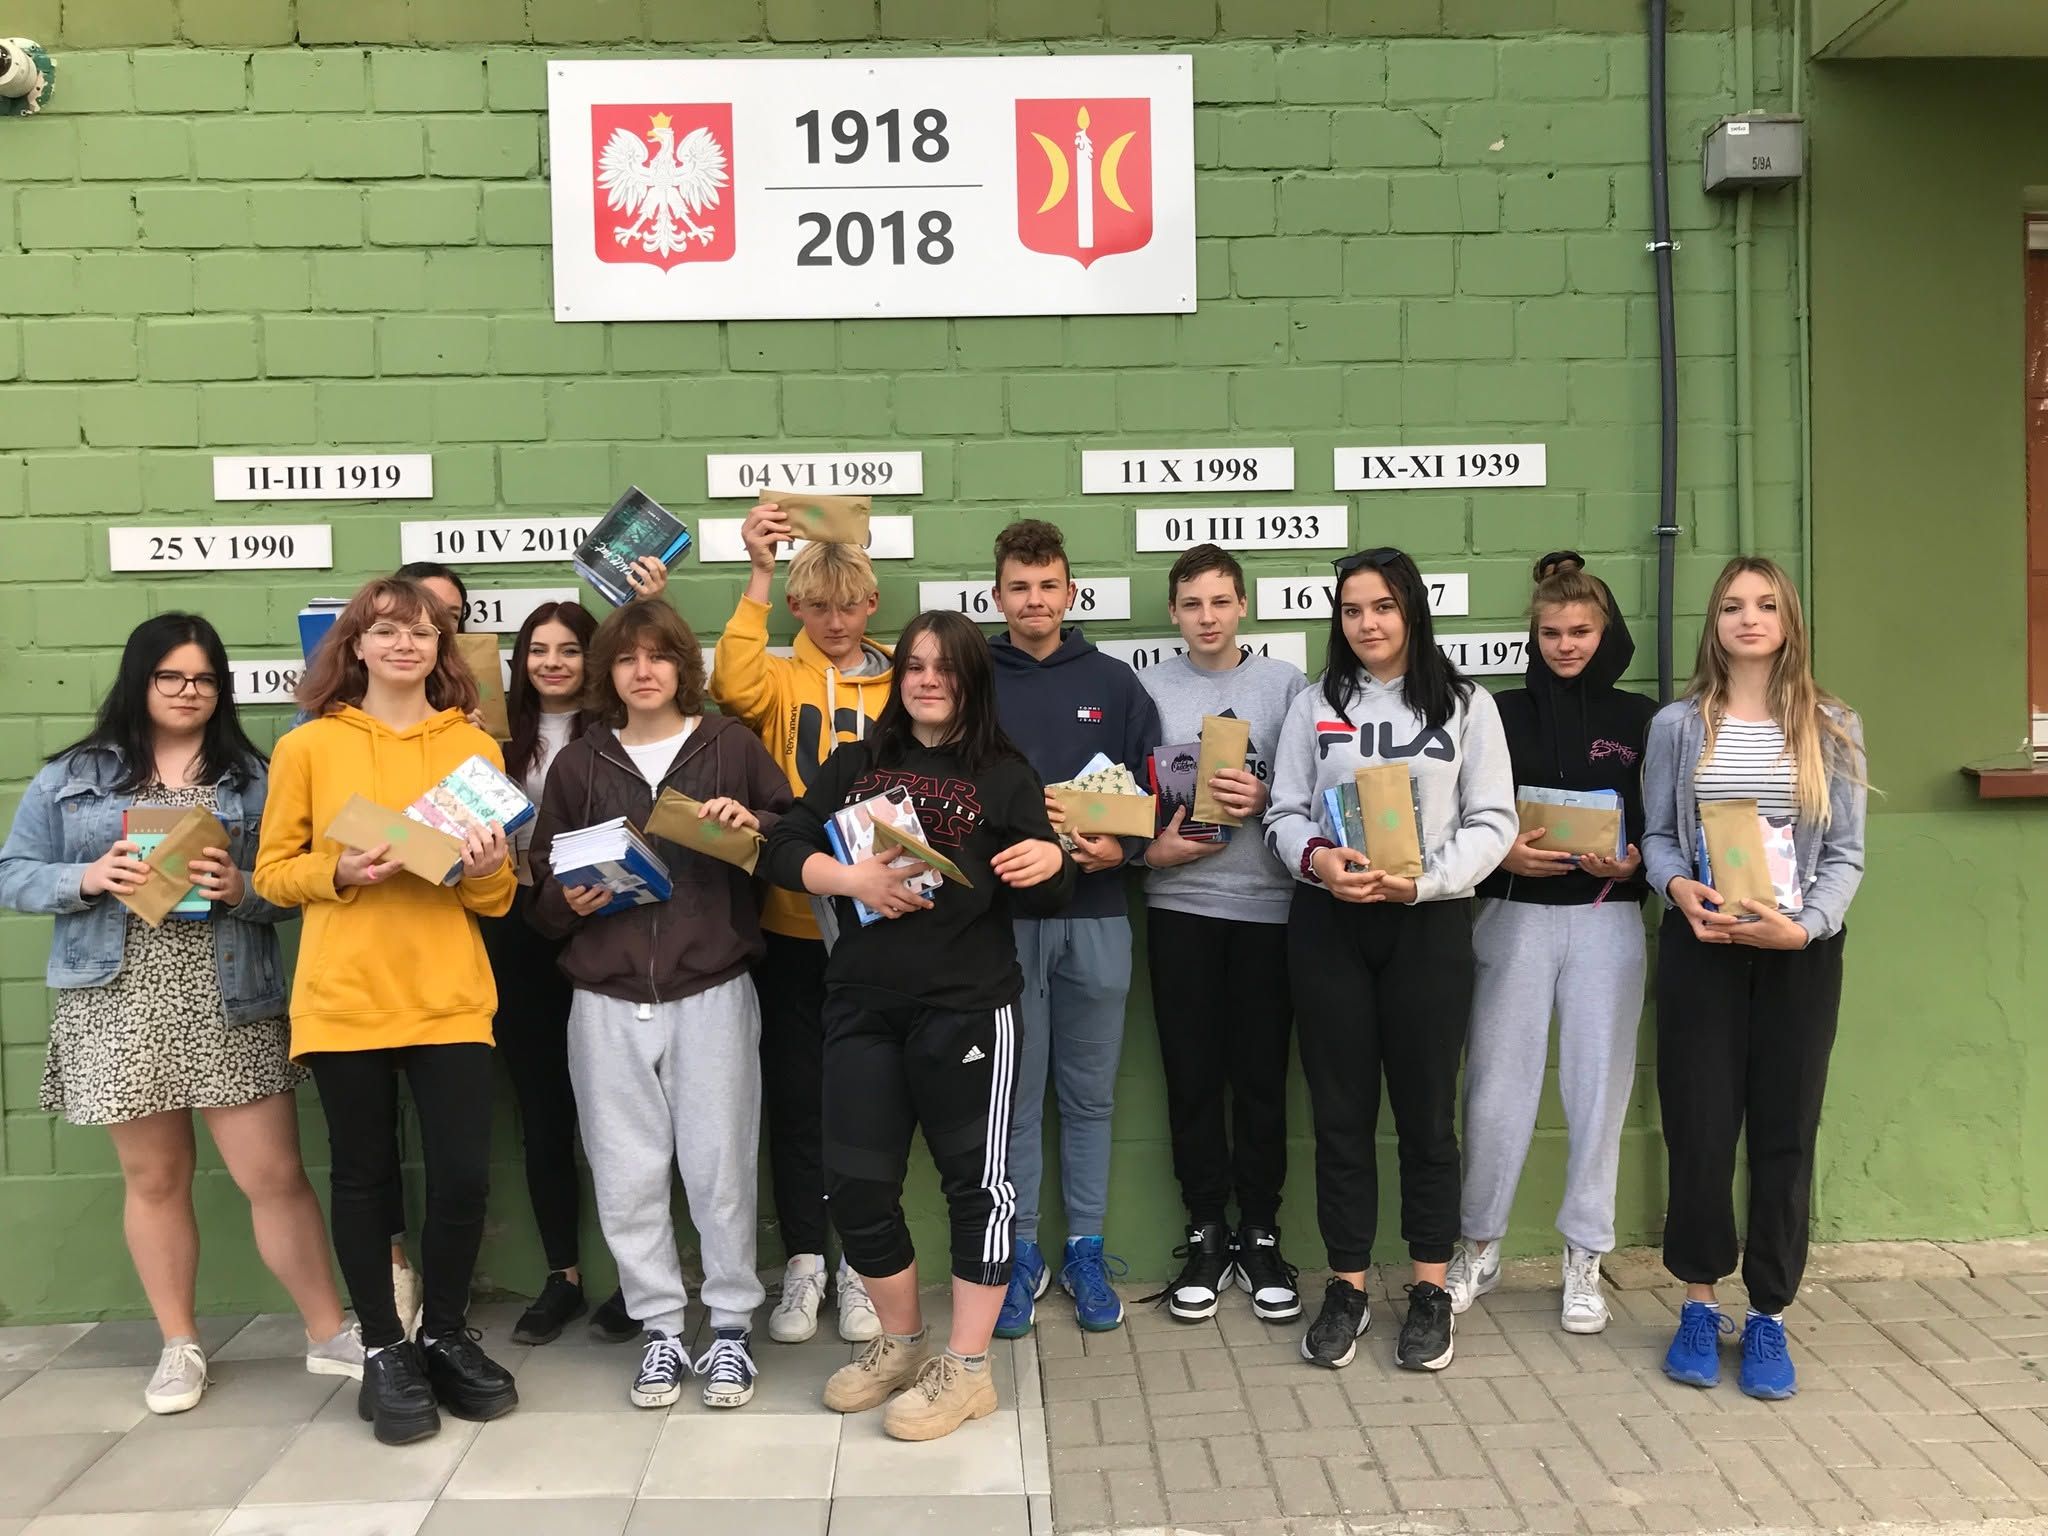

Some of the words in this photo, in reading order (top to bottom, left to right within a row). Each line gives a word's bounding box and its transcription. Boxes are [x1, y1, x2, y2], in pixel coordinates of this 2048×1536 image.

[795, 109, 950, 164] 1918
[1752, 156, 1772, 170] 5/9A
[797, 211, 955, 266] 2018
[247, 467, 324, 490] II-III
[336, 466, 401, 489] 1919
[739, 465, 771, 486] 04
[780, 464, 816, 486] VI
[829, 462, 893, 485] 1989
[1121, 460, 1148, 482] 11
[1160, 460, 1183, 482] X
[1193, 459, 1258, 482] 1998
[1361, 456, 1445, 479] IX-XI
[1456, 454, 1520, 477] 1939
[434, 531, 465, 553] 10
[475, 530, 512, 553] IV
[521, 528, 586, 552] 2010
[1165, 518, 1195, 541] 01
[1206, 518, 1246, 540] III
[1256, 516, 1320, 540] 1933
[149, 537, 183, 560] 25
[193, 538, 217, 559] V
[228, 536, 294, 559] 1990
[957, 590, 989, 614] 16
[1281, 586, 1313, 609] 16
[1132, 646, 1161, 670] 01
[250, 669, 307, 694] 198
[1316, 721, 1456, 763] FILA
[849, 769, 981, 814] STAR
[914, 807, 973, 847] RS
